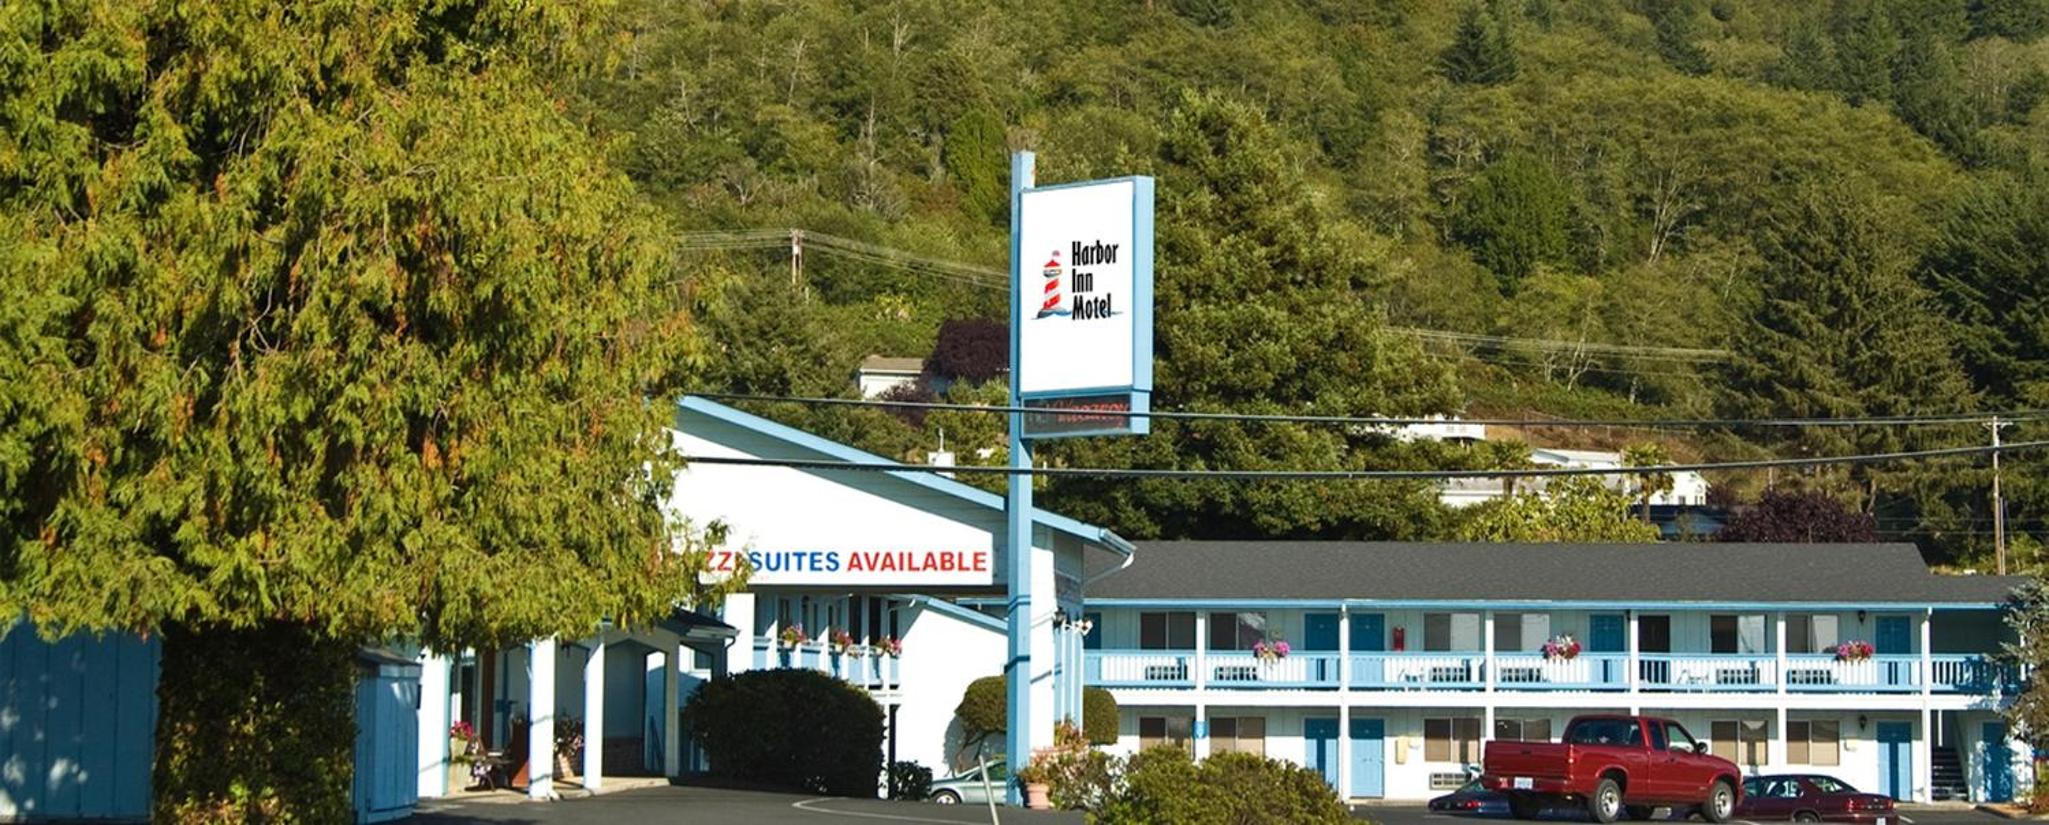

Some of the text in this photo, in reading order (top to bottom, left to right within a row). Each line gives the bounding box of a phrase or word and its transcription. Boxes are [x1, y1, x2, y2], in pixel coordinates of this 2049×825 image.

[1071, 239, 1119, 267] Harbor
[1071, 267, 1094, 294] Inn
[1071, 292, 1112, 321] Motel
[749, 551, 840, 572] SUITES
[847, 551, 987, 572] AVAILABLE
